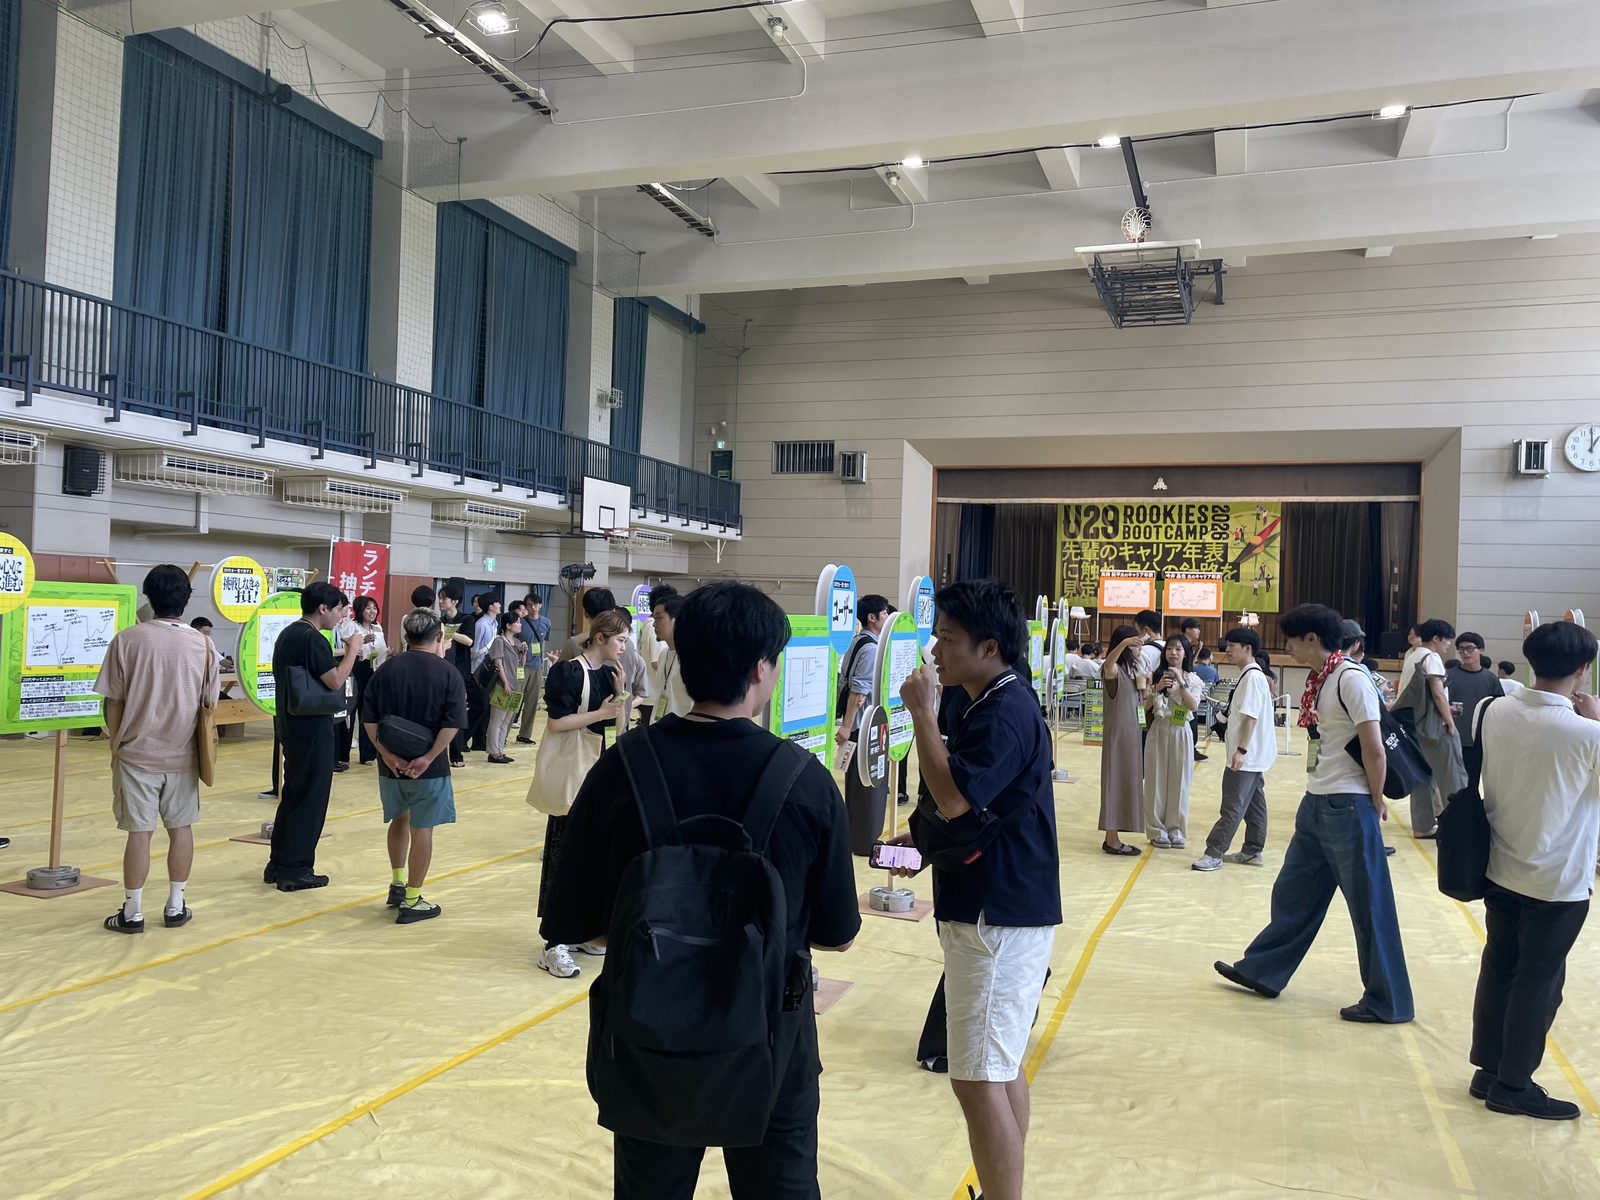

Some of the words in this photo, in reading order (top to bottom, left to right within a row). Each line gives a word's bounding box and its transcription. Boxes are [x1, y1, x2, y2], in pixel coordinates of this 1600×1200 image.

[1064, 505, 1119, 539] U29
[1123, 505, 1208, 524] ROOKIES
[1211, 505, 1230, 540] 2026
[1062, 541, 1224, 562] 先輩のキャリア年表
[0, 558, 22, 575] 心に
[359, 549, 378, 596] ランチ
